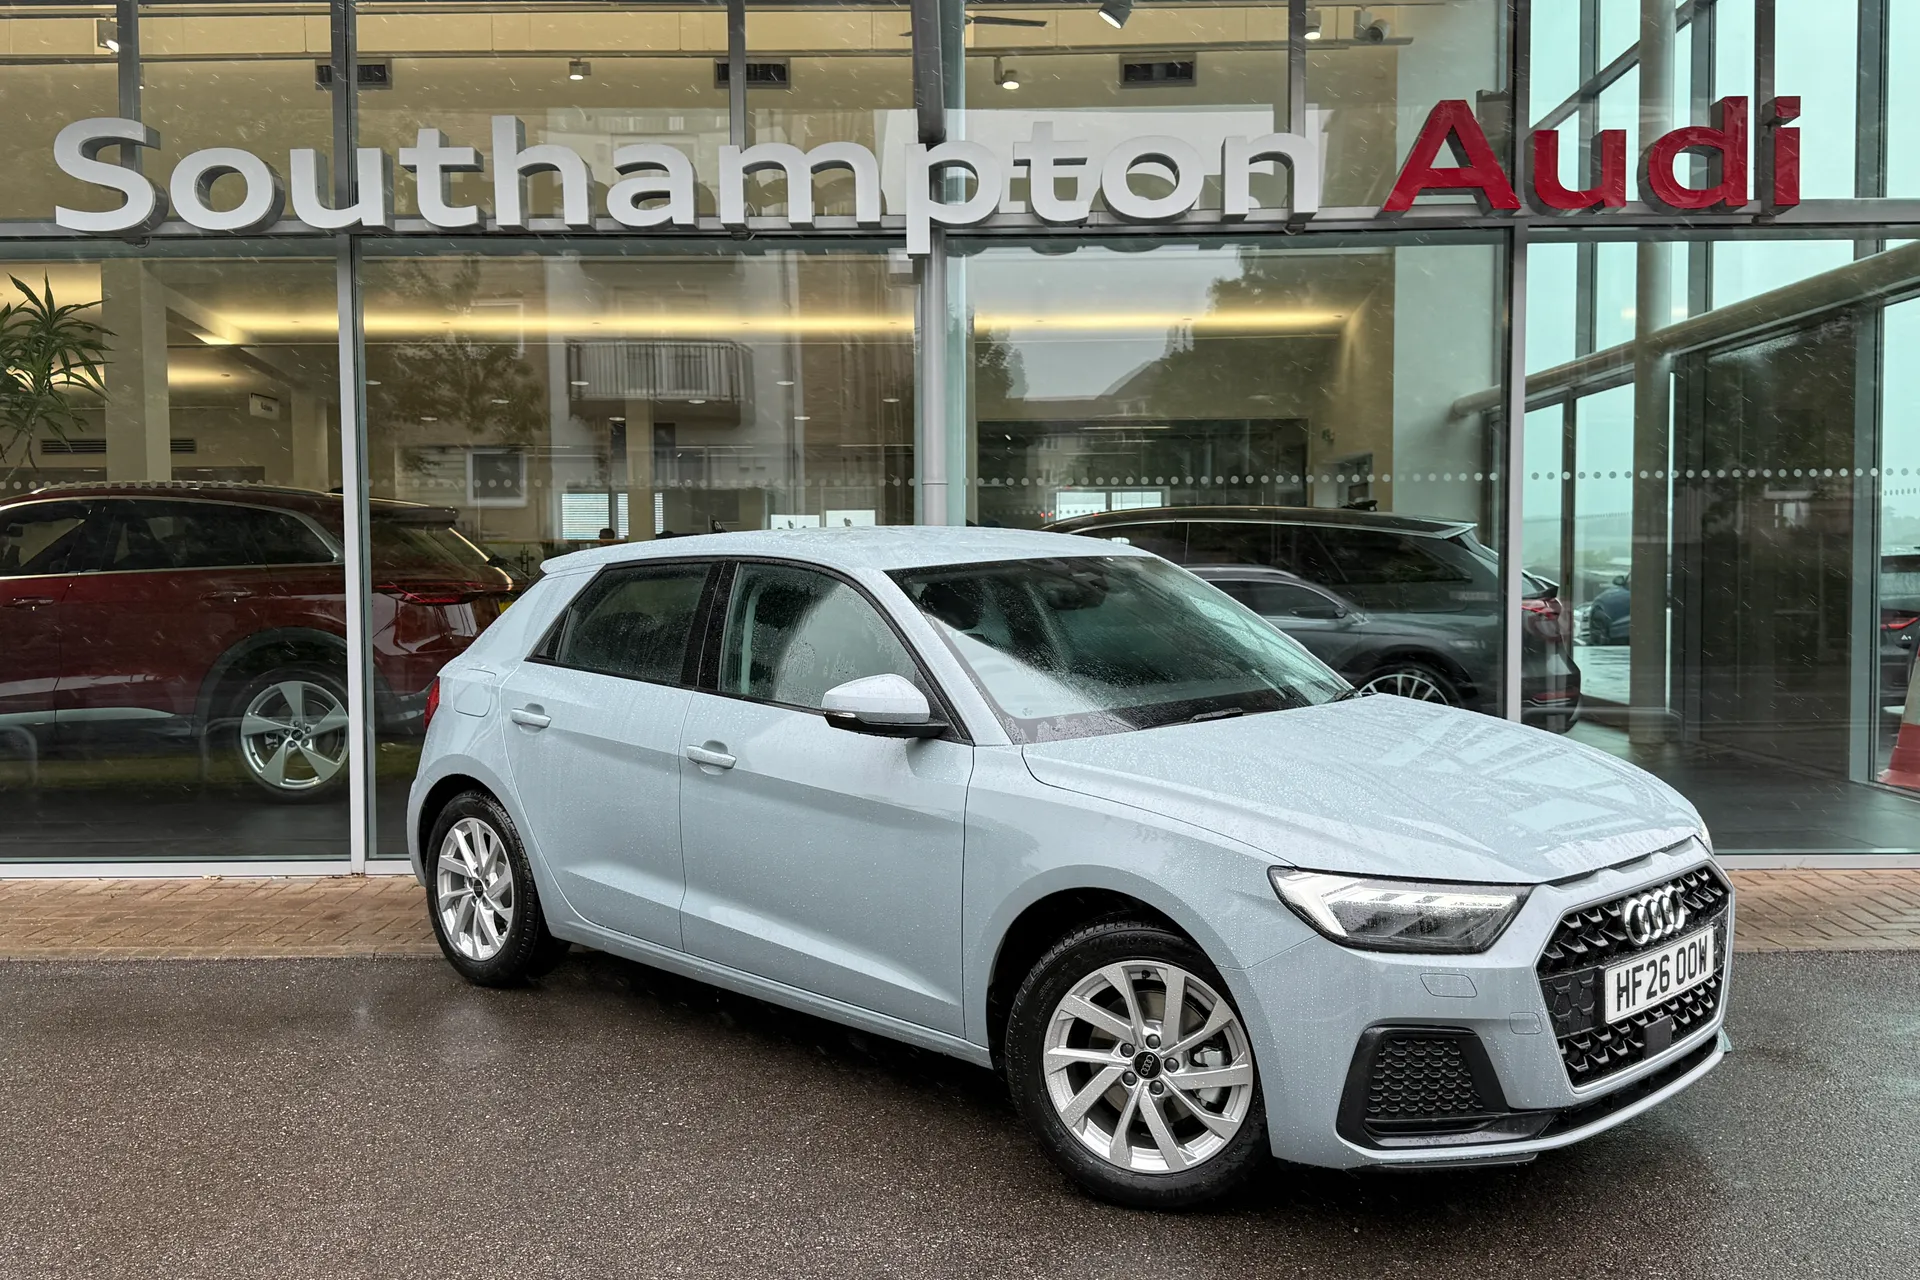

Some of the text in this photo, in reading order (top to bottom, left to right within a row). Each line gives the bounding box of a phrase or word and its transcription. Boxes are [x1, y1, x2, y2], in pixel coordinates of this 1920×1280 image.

[53, 95, 1801, 257] Southampton Audi
[1616, 954, 1670, 1012] HF26
